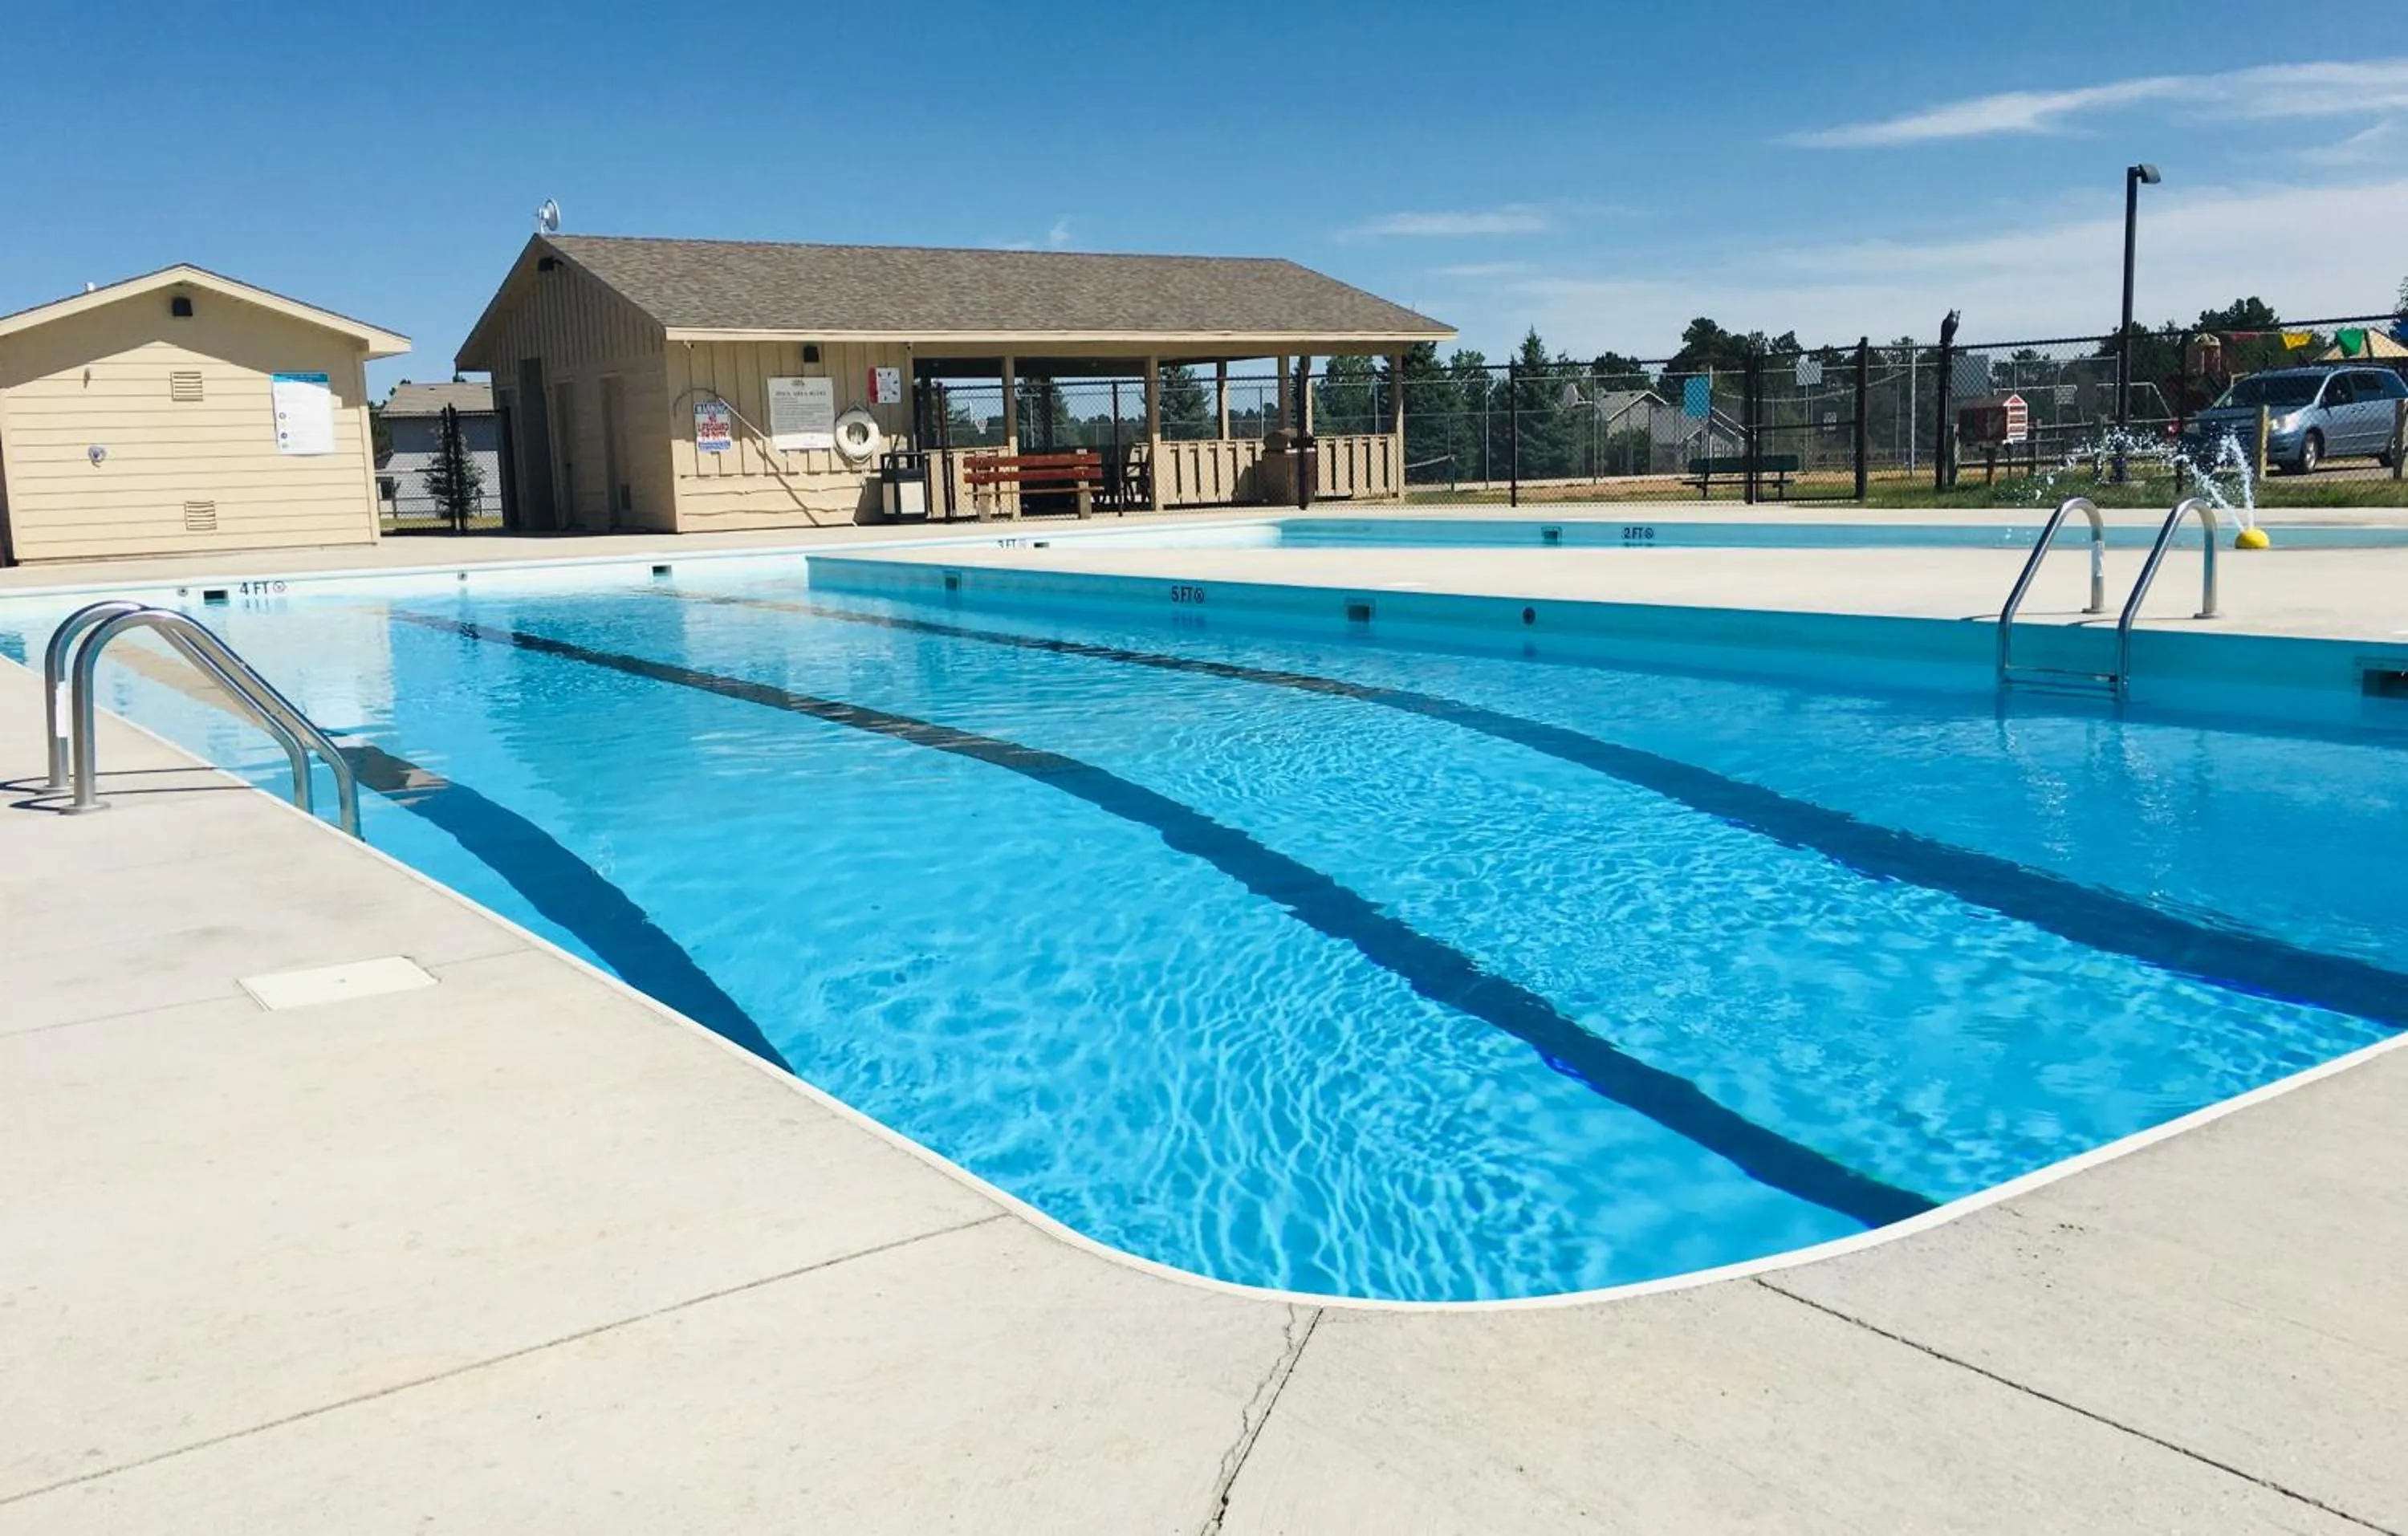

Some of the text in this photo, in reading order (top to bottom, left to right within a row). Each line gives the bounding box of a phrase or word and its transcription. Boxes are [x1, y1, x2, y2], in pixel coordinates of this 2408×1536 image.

[1632, 527, 1643, 539] FT
[240, 581, 270, 595] 4 FT
[1171, 585, 1193, 603] 5 FT
